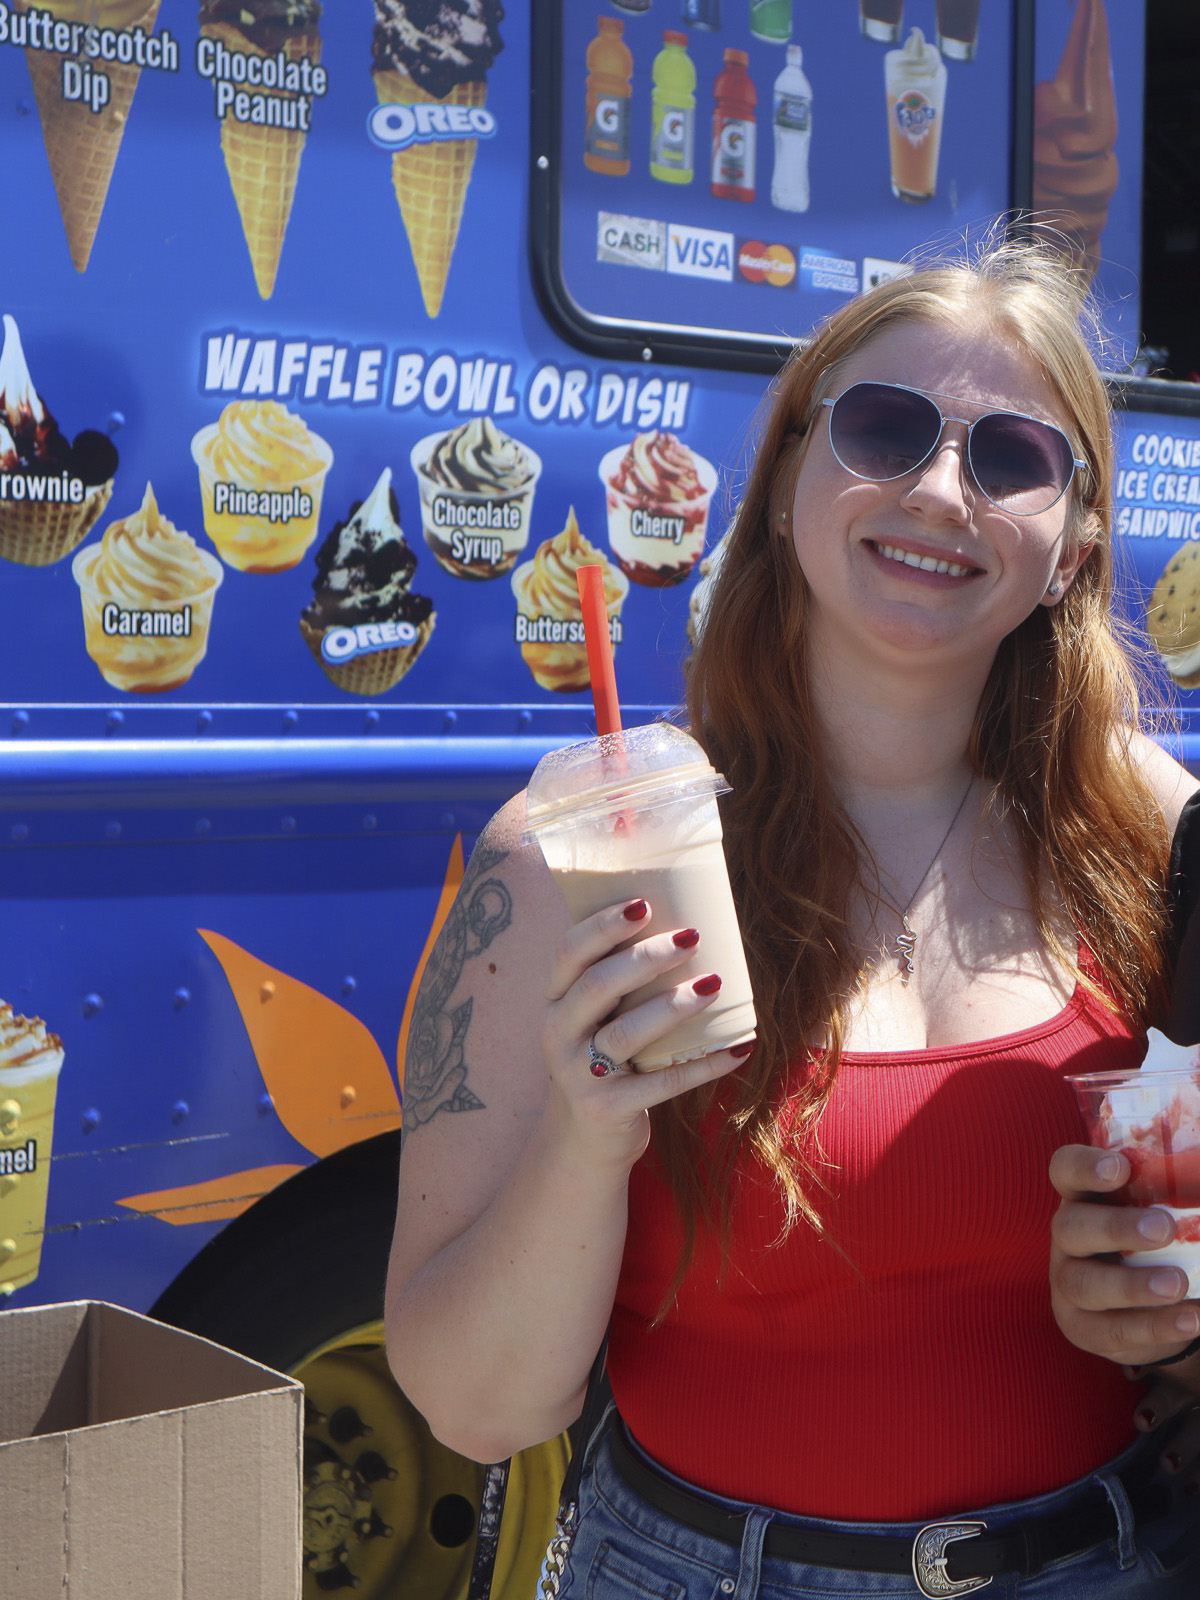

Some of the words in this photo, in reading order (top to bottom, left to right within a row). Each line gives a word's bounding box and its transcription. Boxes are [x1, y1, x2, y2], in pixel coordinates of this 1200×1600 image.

[0, 3, 178, 70] Butterscotch
[199, 40, 326, 95] Chocolate
[63, 60, 109, 113] Dip
[218, 83, 309, 130] Peanut
[371, 105, 494, 142] OREO
[605, 228, 660, 254] CASH
[672, 235, 730, 271] VISA
[205, 334, 382, 401] WAFFLE
[393, 354, 515, 413] BOWL
[530, 366, 585, 420] OR
[596, 376, 689, 428] DISH
[1, 470, 83, 502] rownie
[1117, 470, 1148, 499] ICE
[215, 485, 311, 521] Pineapple
[434, 498, 520, 529] Chocolate
[632, 511, 684, 544] Cherry
[452, 531, 502, 564] Syrup
[104, 606, 191, 636] Caramel
[516, 615, 622, 642] Buttersch
[323, 622, 417, 658] OREO
